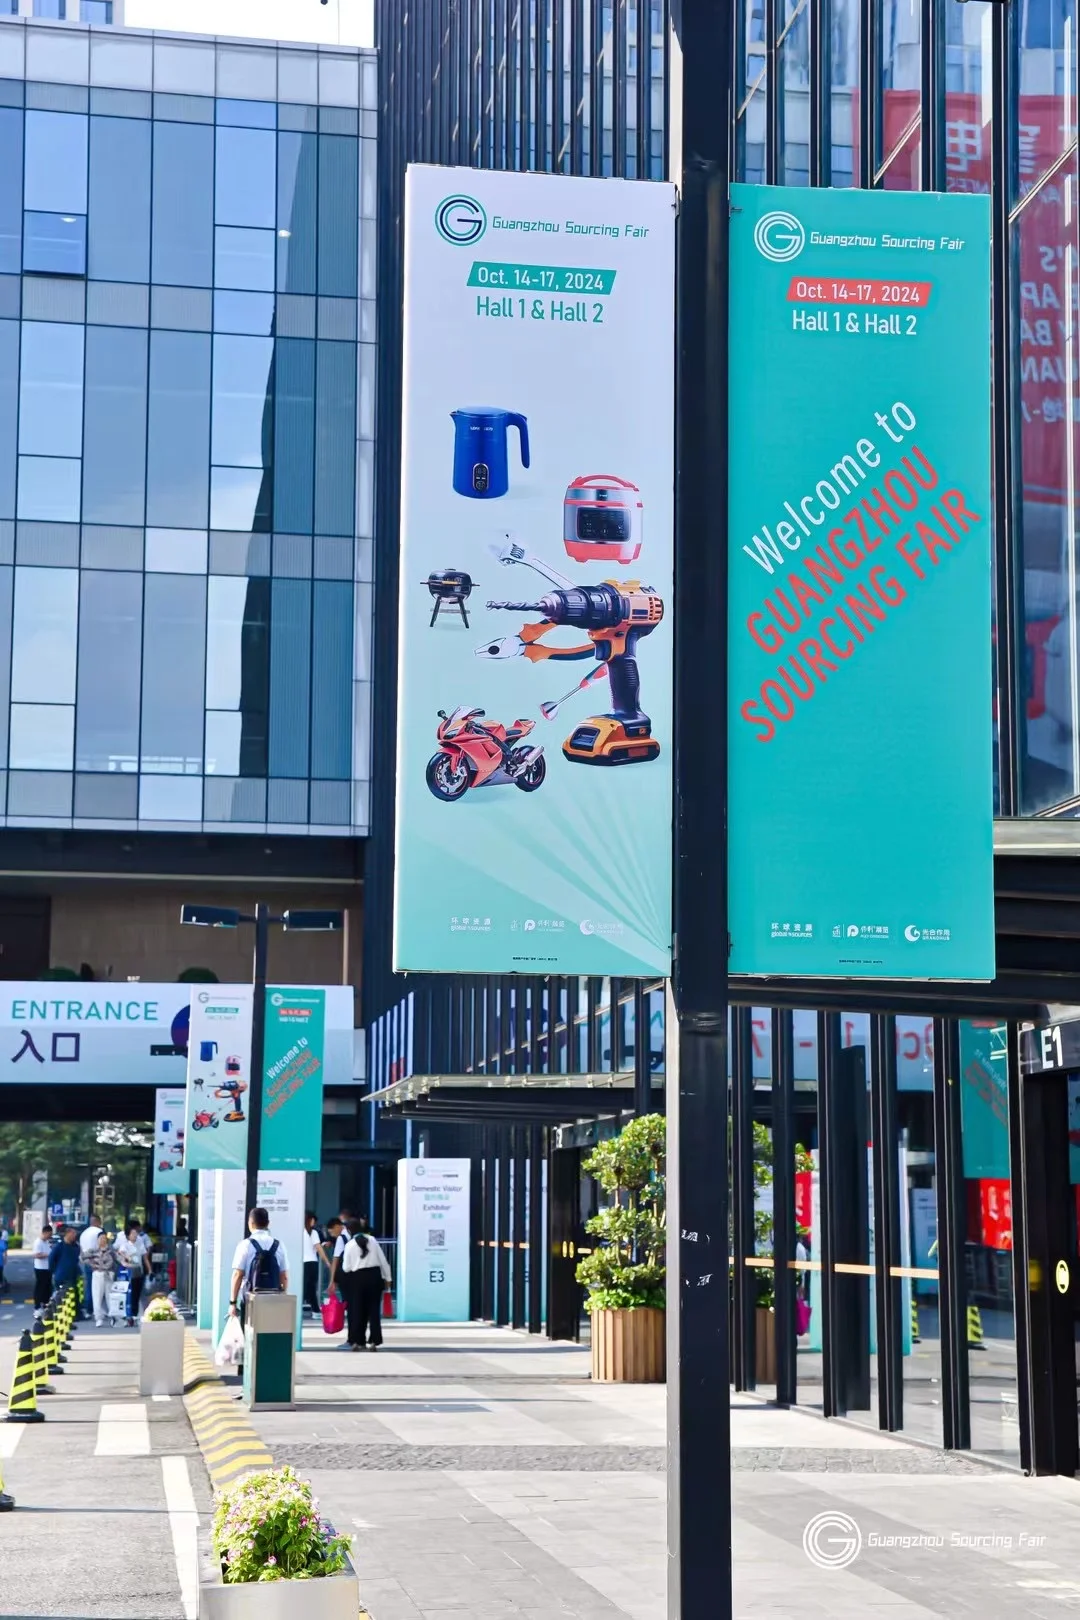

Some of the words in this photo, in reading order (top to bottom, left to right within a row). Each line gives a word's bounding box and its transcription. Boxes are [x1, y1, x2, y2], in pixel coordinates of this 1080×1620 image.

[492, 216, 560, 233] Guangzhou
[565, 221, 620, 238] Sourcing
[624, 224, 650, 238] Fair
[810, 231, 877, 247] Guangzhou
[881, 234, 935, 251] Sourcing
[940, 237, 965, 250] Fair
[477, 266, 509, 285] Oct.
[513, 269, 559, 291] 14-17,
[564, 272, 604, 290] 2024
[796, 281, 827, 299] Oct.
[831, 283, 876, 303] 14-17,
[881, 285, 920, 303] 2024
[476, 295, 514, 318] Hall
[518, 298, 526, 319] 1
[530, 299, 545, 320] &
[550, 300, 587, 322] Hall
[592, 303, 604, 323] 2
[792, 310, 829, 332] Hall
[833, 311, 841, 332] 1
[845, 312, 860, 333] &
[865, 313, 901, 335] Hall
[905, 315, 917, 335] 2
[743, 437, 881, 575] Welcome
[874, 401, 917, 443] to
[746, 445, 939, 654] GUANGZHOU
[740, 565, 908, 743] SOURCING
[895, 488, 981, 580] FAIR
[11, 1000, 159, 1021] ENTRANCE
[11, 1029, 81, 1063] 入口
[1041, 1026, 1063, 1069] E1
[429, 1270, 445, 1283] E3
